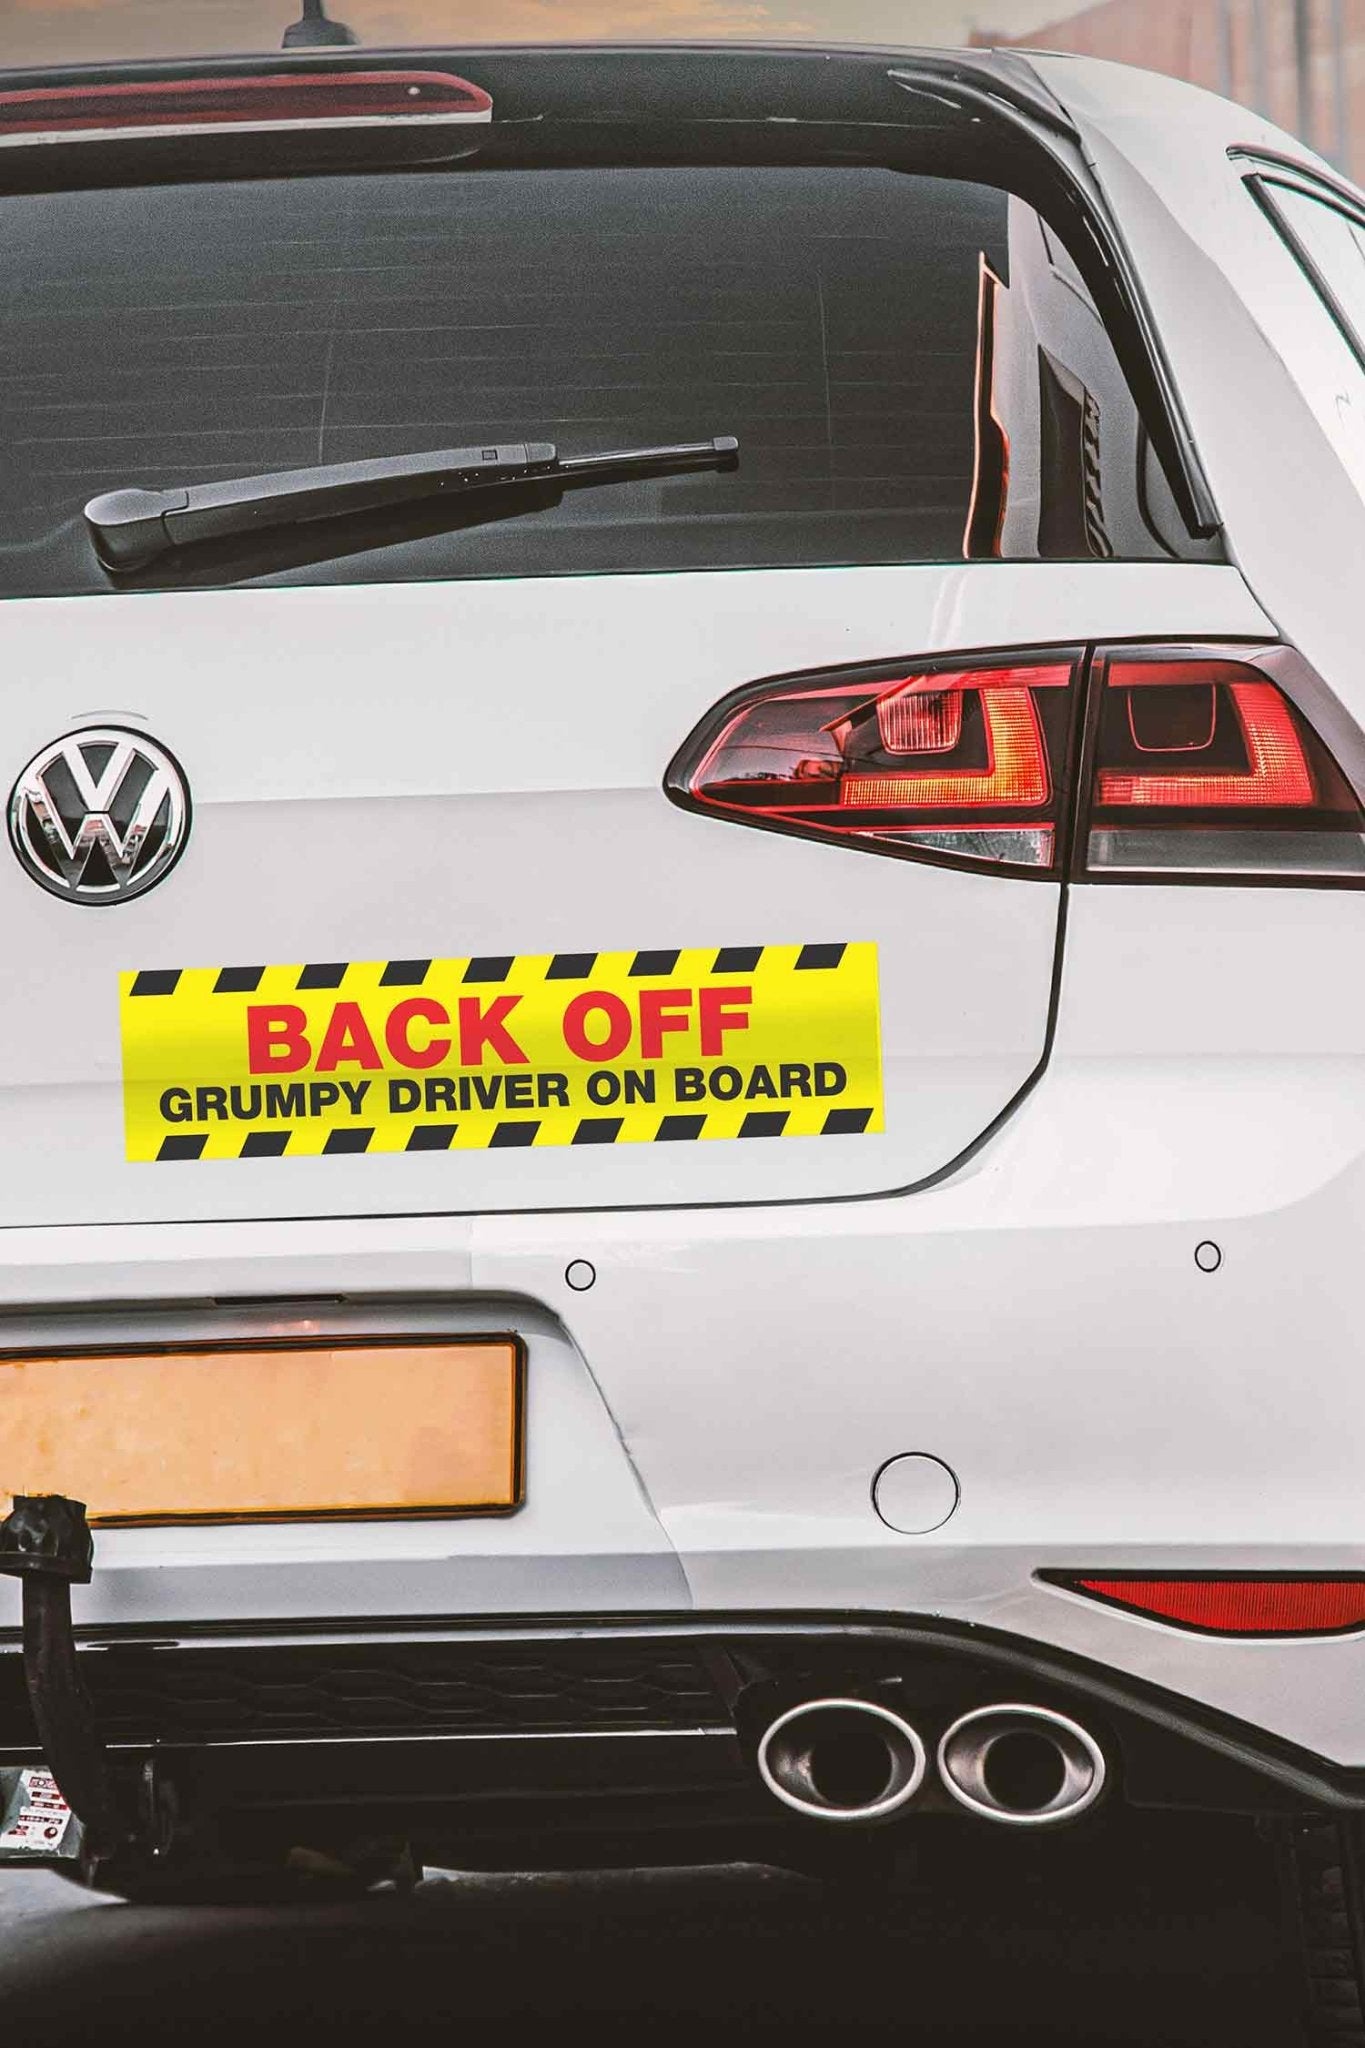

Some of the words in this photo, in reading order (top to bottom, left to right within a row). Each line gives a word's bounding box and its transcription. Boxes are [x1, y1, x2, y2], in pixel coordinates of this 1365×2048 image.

[23, 738, 171, 888] VW
[246, 995, 530, 1075] BACK
[562, 986, 753, 1063] OFF
[159, 1081, 372, 1123] GRUMPY
[388, 1073, 570, 1114] DRIVER
[586, 1069, 656, 1106] ON
[674, 1061, 847, 1102] BOARD
